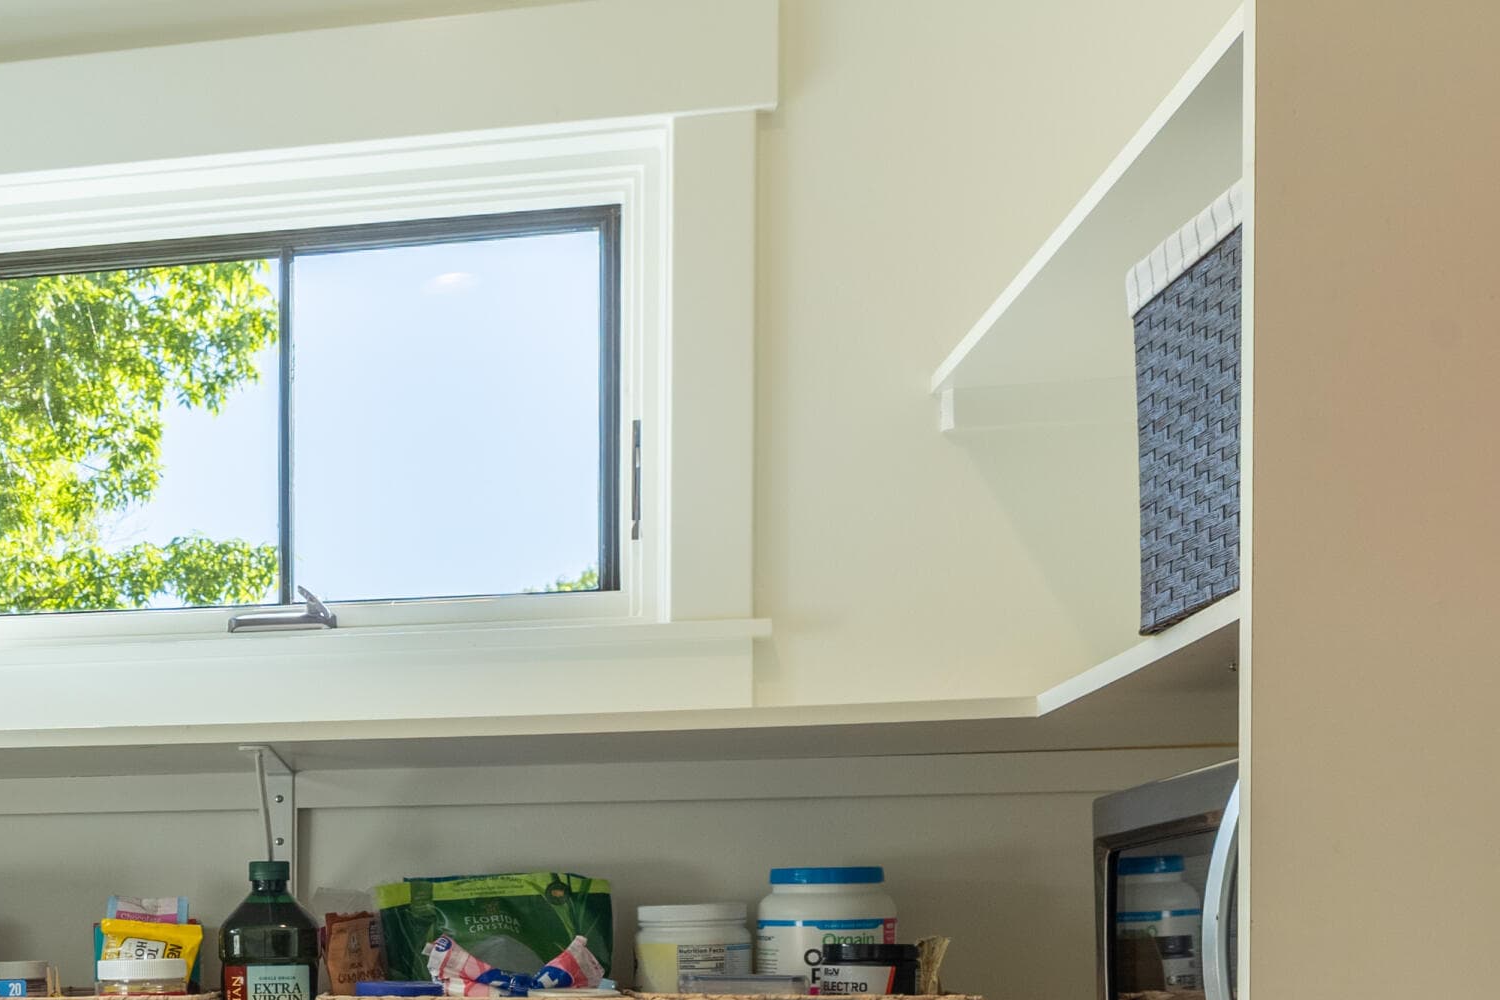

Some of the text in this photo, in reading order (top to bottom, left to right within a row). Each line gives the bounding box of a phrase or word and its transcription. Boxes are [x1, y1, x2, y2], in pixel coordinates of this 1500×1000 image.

[464, 914, 521, 927] FLORIDA
[468, 922, 521, 935] CRYSTALS
[8, 982, 22, 997] 20
[254, 983, 302, 994] EXTRA
[823, 980, 868, 993] ELECTRO
